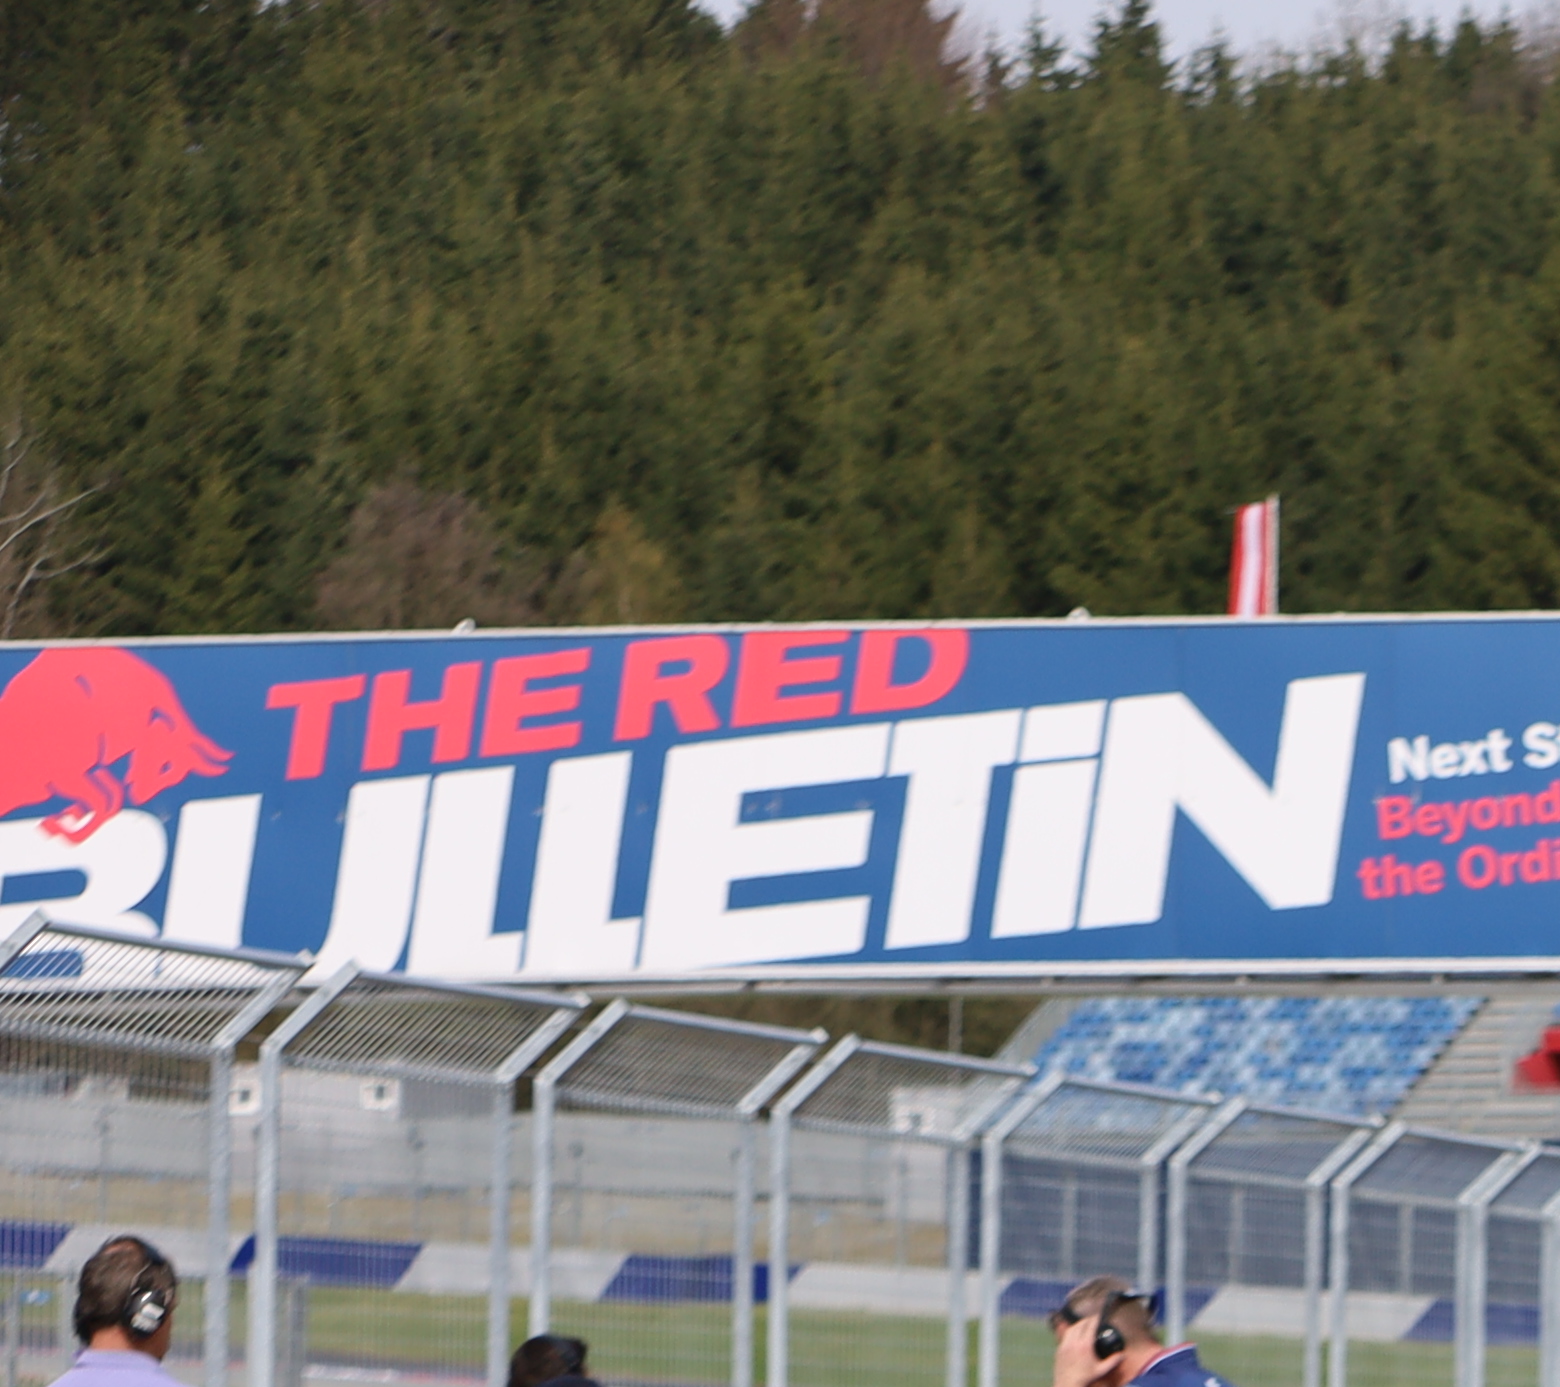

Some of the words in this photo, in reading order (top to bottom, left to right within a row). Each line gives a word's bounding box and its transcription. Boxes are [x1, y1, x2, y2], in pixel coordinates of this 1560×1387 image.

[266, 647, 593, 781] THE
[612, 628, 971, 742] RED
[1388, 728, 1512, 783] Next
[1358, 853, 1445, 900] the
